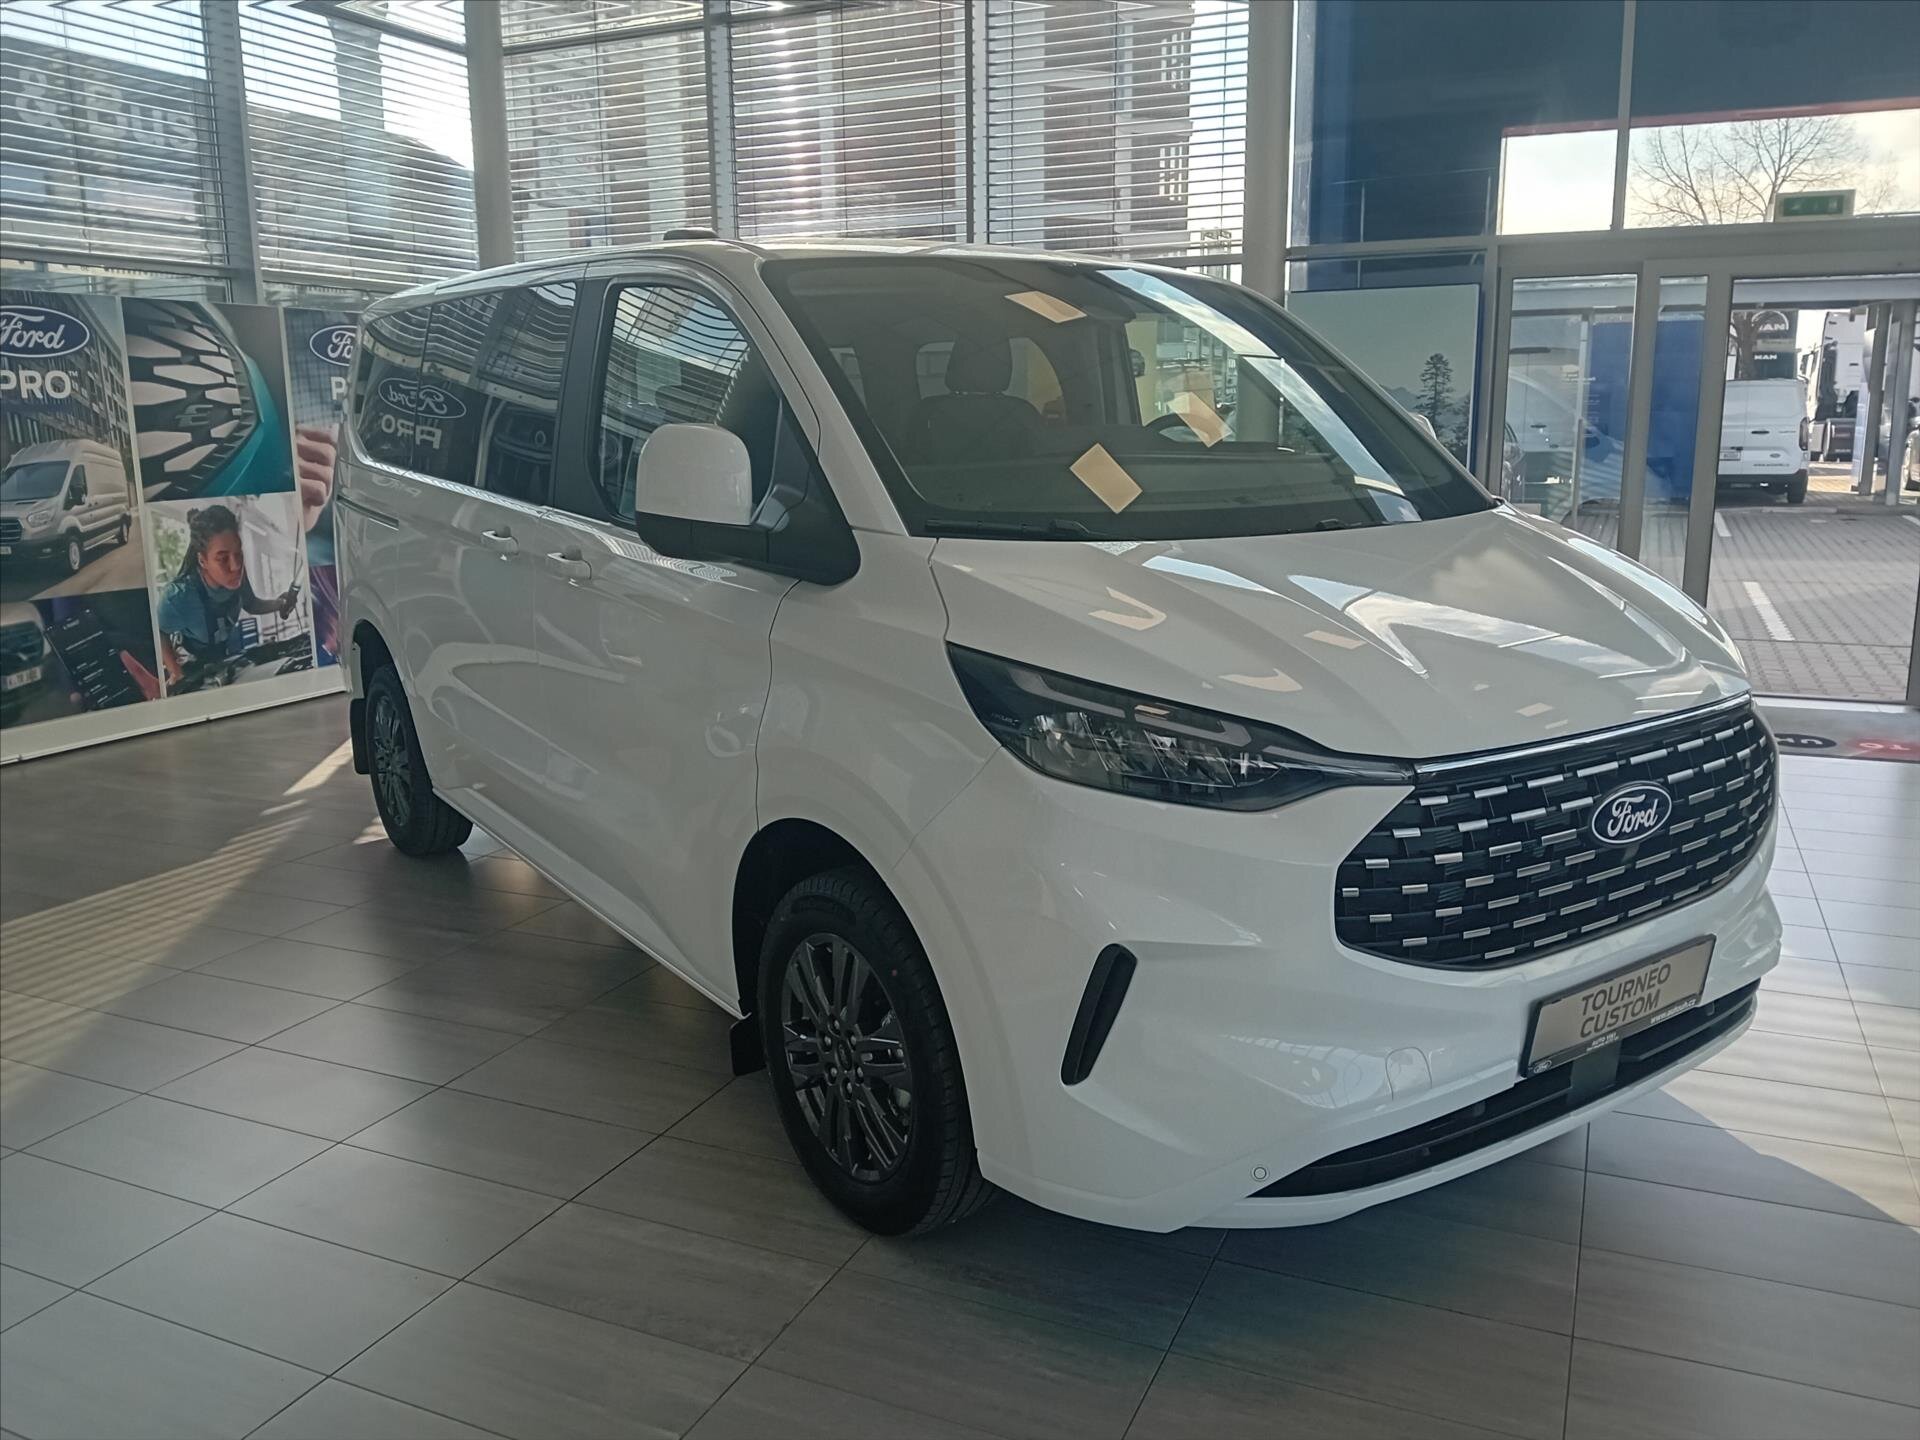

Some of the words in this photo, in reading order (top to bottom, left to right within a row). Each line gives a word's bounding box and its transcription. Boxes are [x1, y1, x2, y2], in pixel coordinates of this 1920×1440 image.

[0, 311, 65, 349] Ford
[1607, 794, 1658, 837] Ford
[1581, 963, 1671, 1016] TOURNEO
[1580, 988, 1661, 1038] CUSTOM
